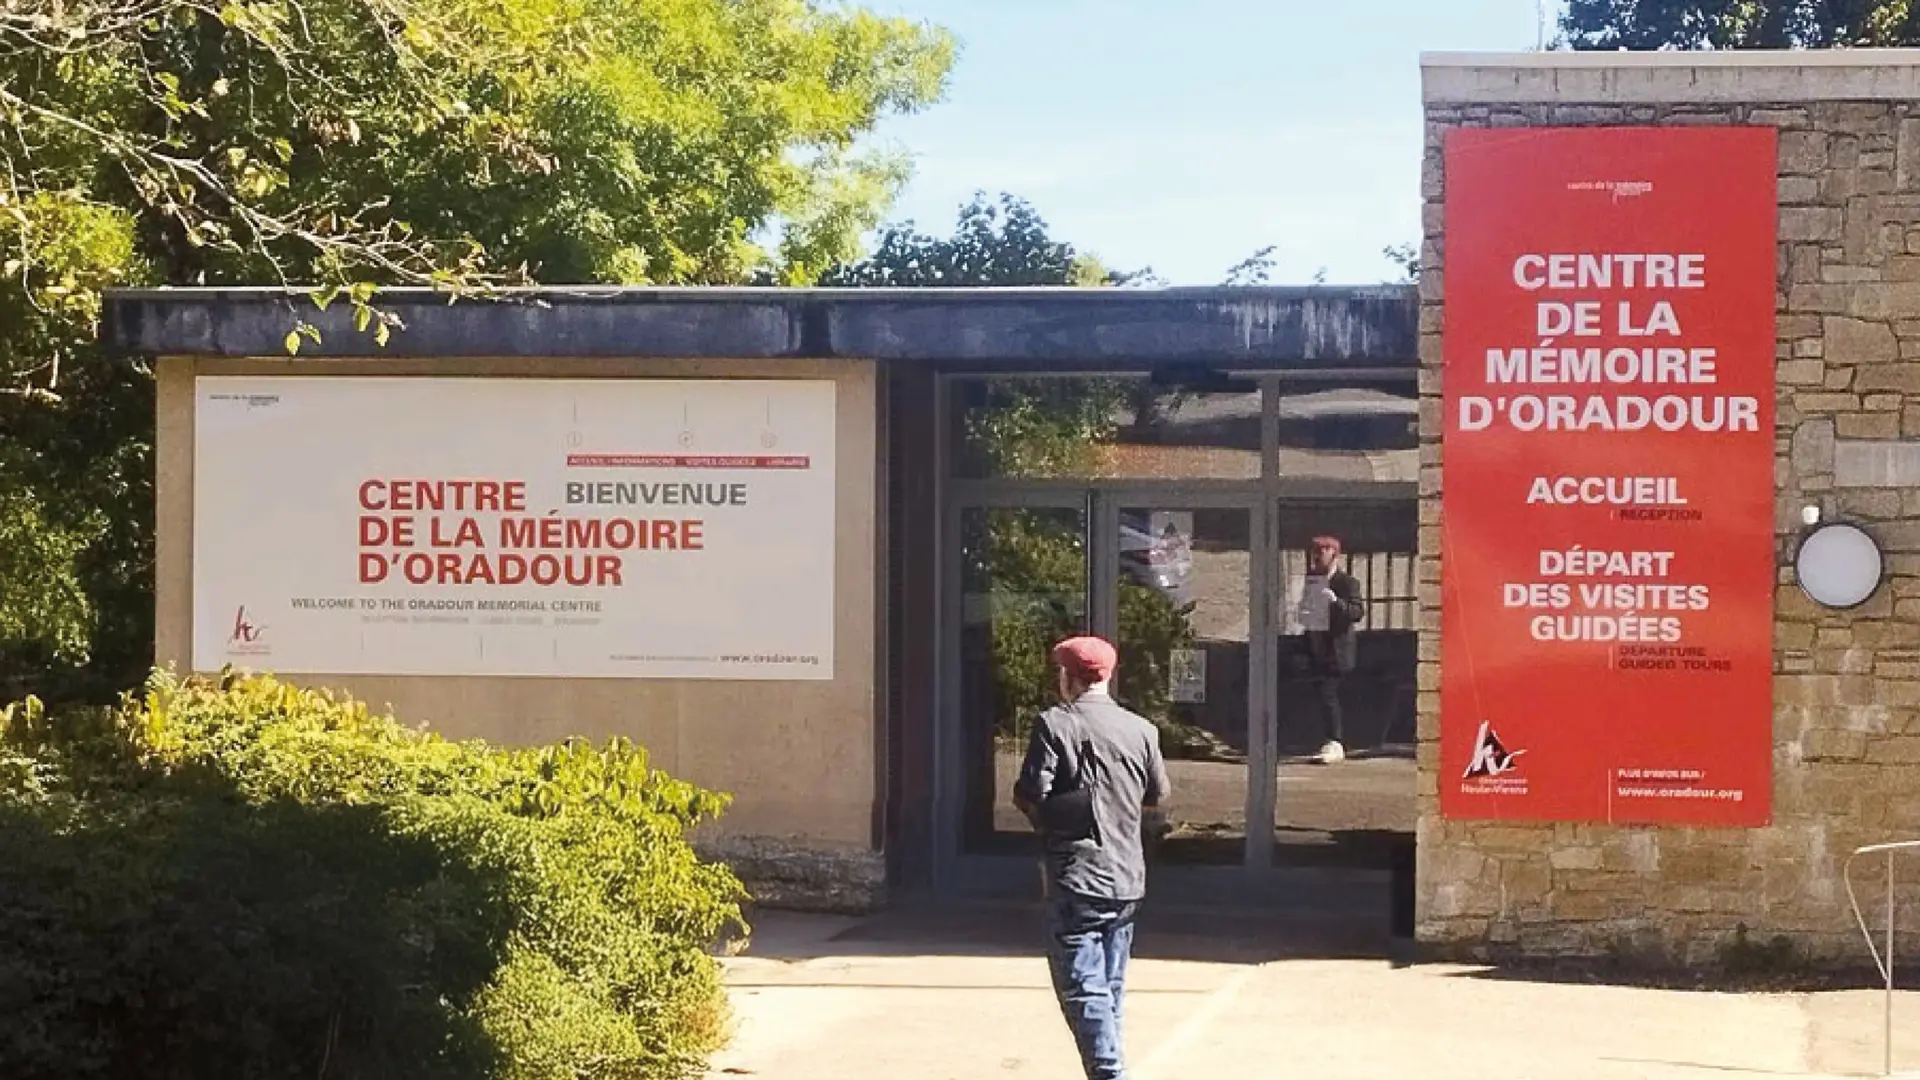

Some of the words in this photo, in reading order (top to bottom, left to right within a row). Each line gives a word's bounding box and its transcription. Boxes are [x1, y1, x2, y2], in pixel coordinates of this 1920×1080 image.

[1513, 253, 1705, 289] CENTRE
[1537, 301, 1602, 336] DE
[1618, 301, 1681, 336] LA
[1486, 338, 1717, 384] MÉMOIRE
[1458, 395, 1759, 432] D'ORADOUR
[358, 479, 526, 511] CENTRE
[566, 482, 747, 505] BIENVENUE
[1527, 477, 1688, 504] ACCUEIL
[359, 516, 414, 547] DE
[431, 517, 485, 548] LA
[500, 509, 704, 549] MÉMOIRE
[1620, 509, 1702, 521] RECEPTION
[358, 553, 622, 585] D’ORADOUR
[1539, 545, 1675, 576] DÉPART
[291, 598, 354, 609] WELCOME
[360, 599, 376, 610] TO
[380, 599, 405, 610] THE
[408, 600, 474, 611] ORADOUR
[477, 600, 546, 611] MEMORIAL
[551, 600, 602, 612] CENTRE
[1503, 583, 1571, 608] DES
[1579, 584, 1709, 610] VISITES
[1531, 611, 1682, 642] GUIDÉES
[1618, 659, 1677, 670] GUIDED
[1682, 660, 1732, 672] TOURS
[1619, 646, 1706, 657] DEPARTURE
[1618, 787, 1743, 801] www.oradour.org
